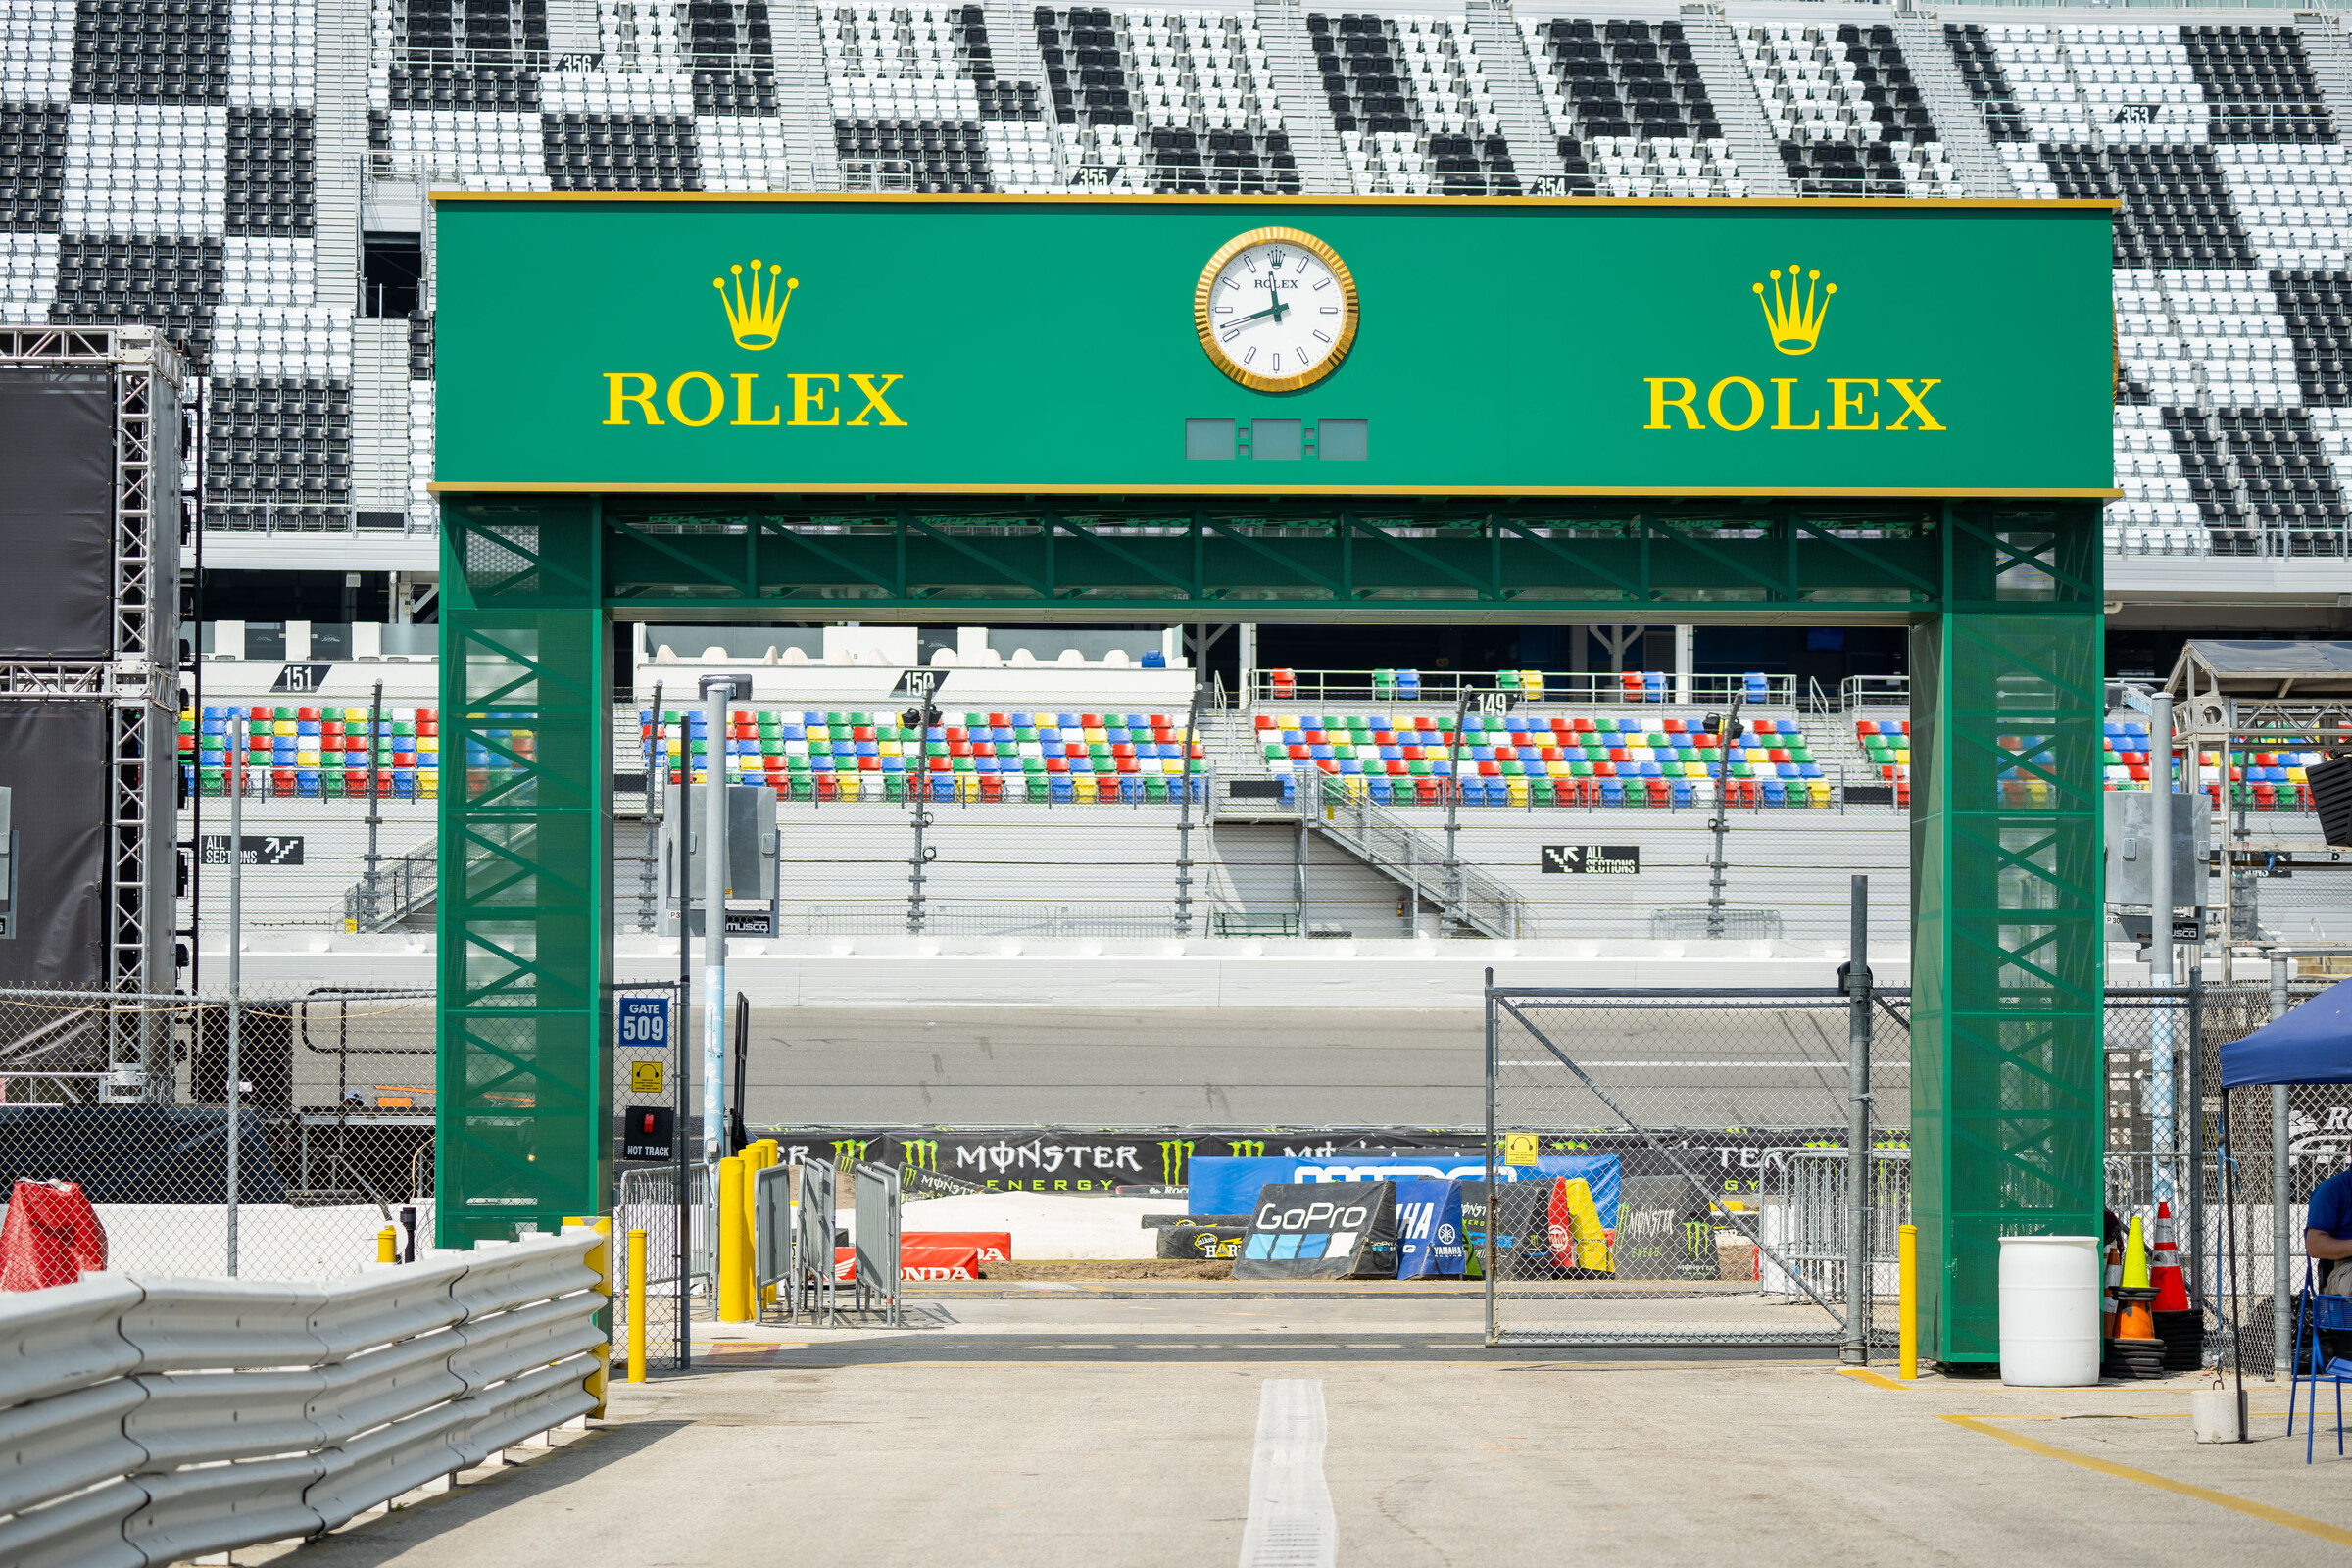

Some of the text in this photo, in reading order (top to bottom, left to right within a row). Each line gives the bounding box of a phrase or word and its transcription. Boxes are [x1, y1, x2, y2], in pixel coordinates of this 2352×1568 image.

[564, 55, 592, 73] 356
[2122, 106, 2149, 124] 353
[1079, 168, 1107, 186] 355
[1537, 177, 1566, 196] 354
[1254, 279, 1298, 289] ROLEX
[602, 370, 908, 427] ROLEX
[1642, 375, 1947, 432] ROLEX
[284, 666, 312, 691] 151
[905, 672, 934, 696] 150
[1477, 693, 1506, 716] 149
[206, 836, 225, 850] ALL
[206, 850, 258, 864] SECTNS
[1586, 846, 1604, 859] ALL
[1586, 859, 1636, 873] SECTIONS
[628, 1004, 660, 1014] GATE
[623, 1015, 664, 1041] 509
[627, 1145, 669, 1156] HOT TRACK
[956, 1140, 1144, 1174] MONSTER
[986, 1179, 1114, 1191] ENERGY
[1256, 1202, 1368, 1230] GoPro
[1205, 1243, 1242, 1259] HAR
[1434, 1246, 1462, 1255] YAMAHA
